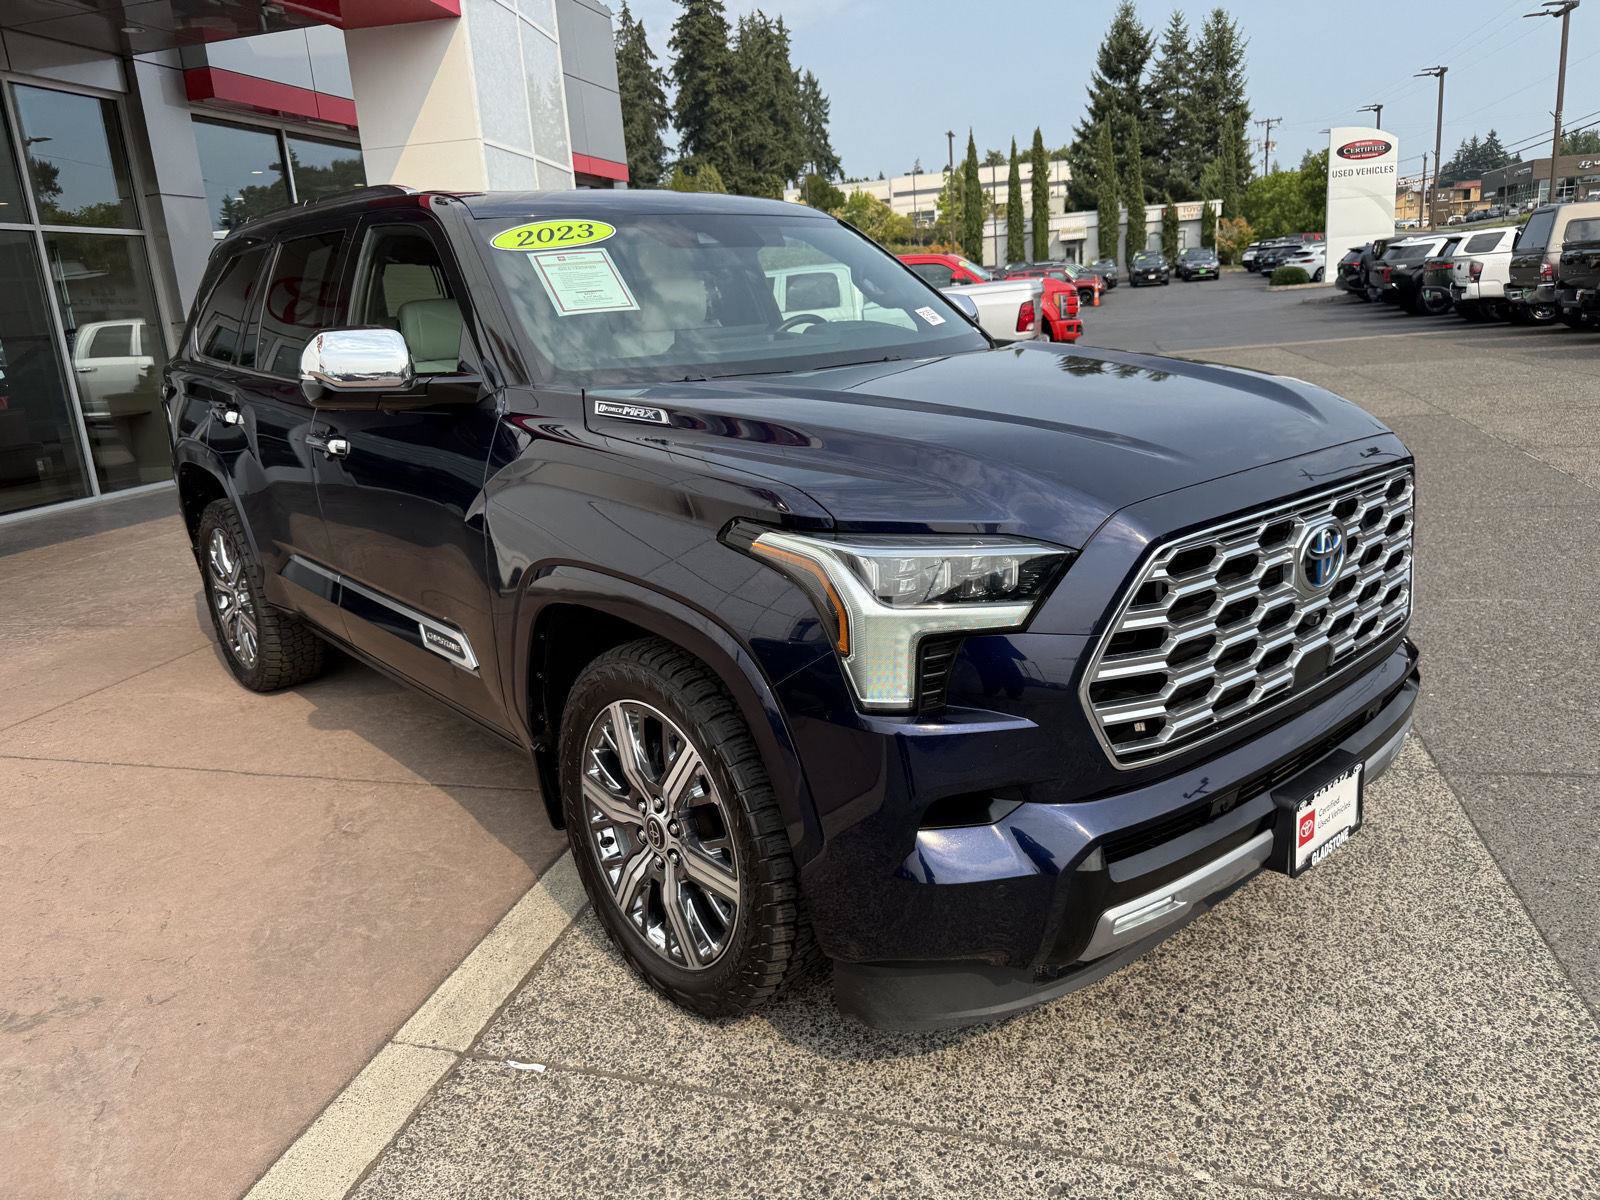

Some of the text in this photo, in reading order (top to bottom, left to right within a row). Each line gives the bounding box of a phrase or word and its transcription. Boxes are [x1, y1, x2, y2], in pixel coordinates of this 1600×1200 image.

[1343, 145, 1386, 155] CERTIFIED
[1331, 165, 1394, 178] USED VEHICLES
[516, 223, 594, 247] 2023
[1318, 795, 1341, 817] Certified
[1311, 826, 1349, 867] GLADSTONE
